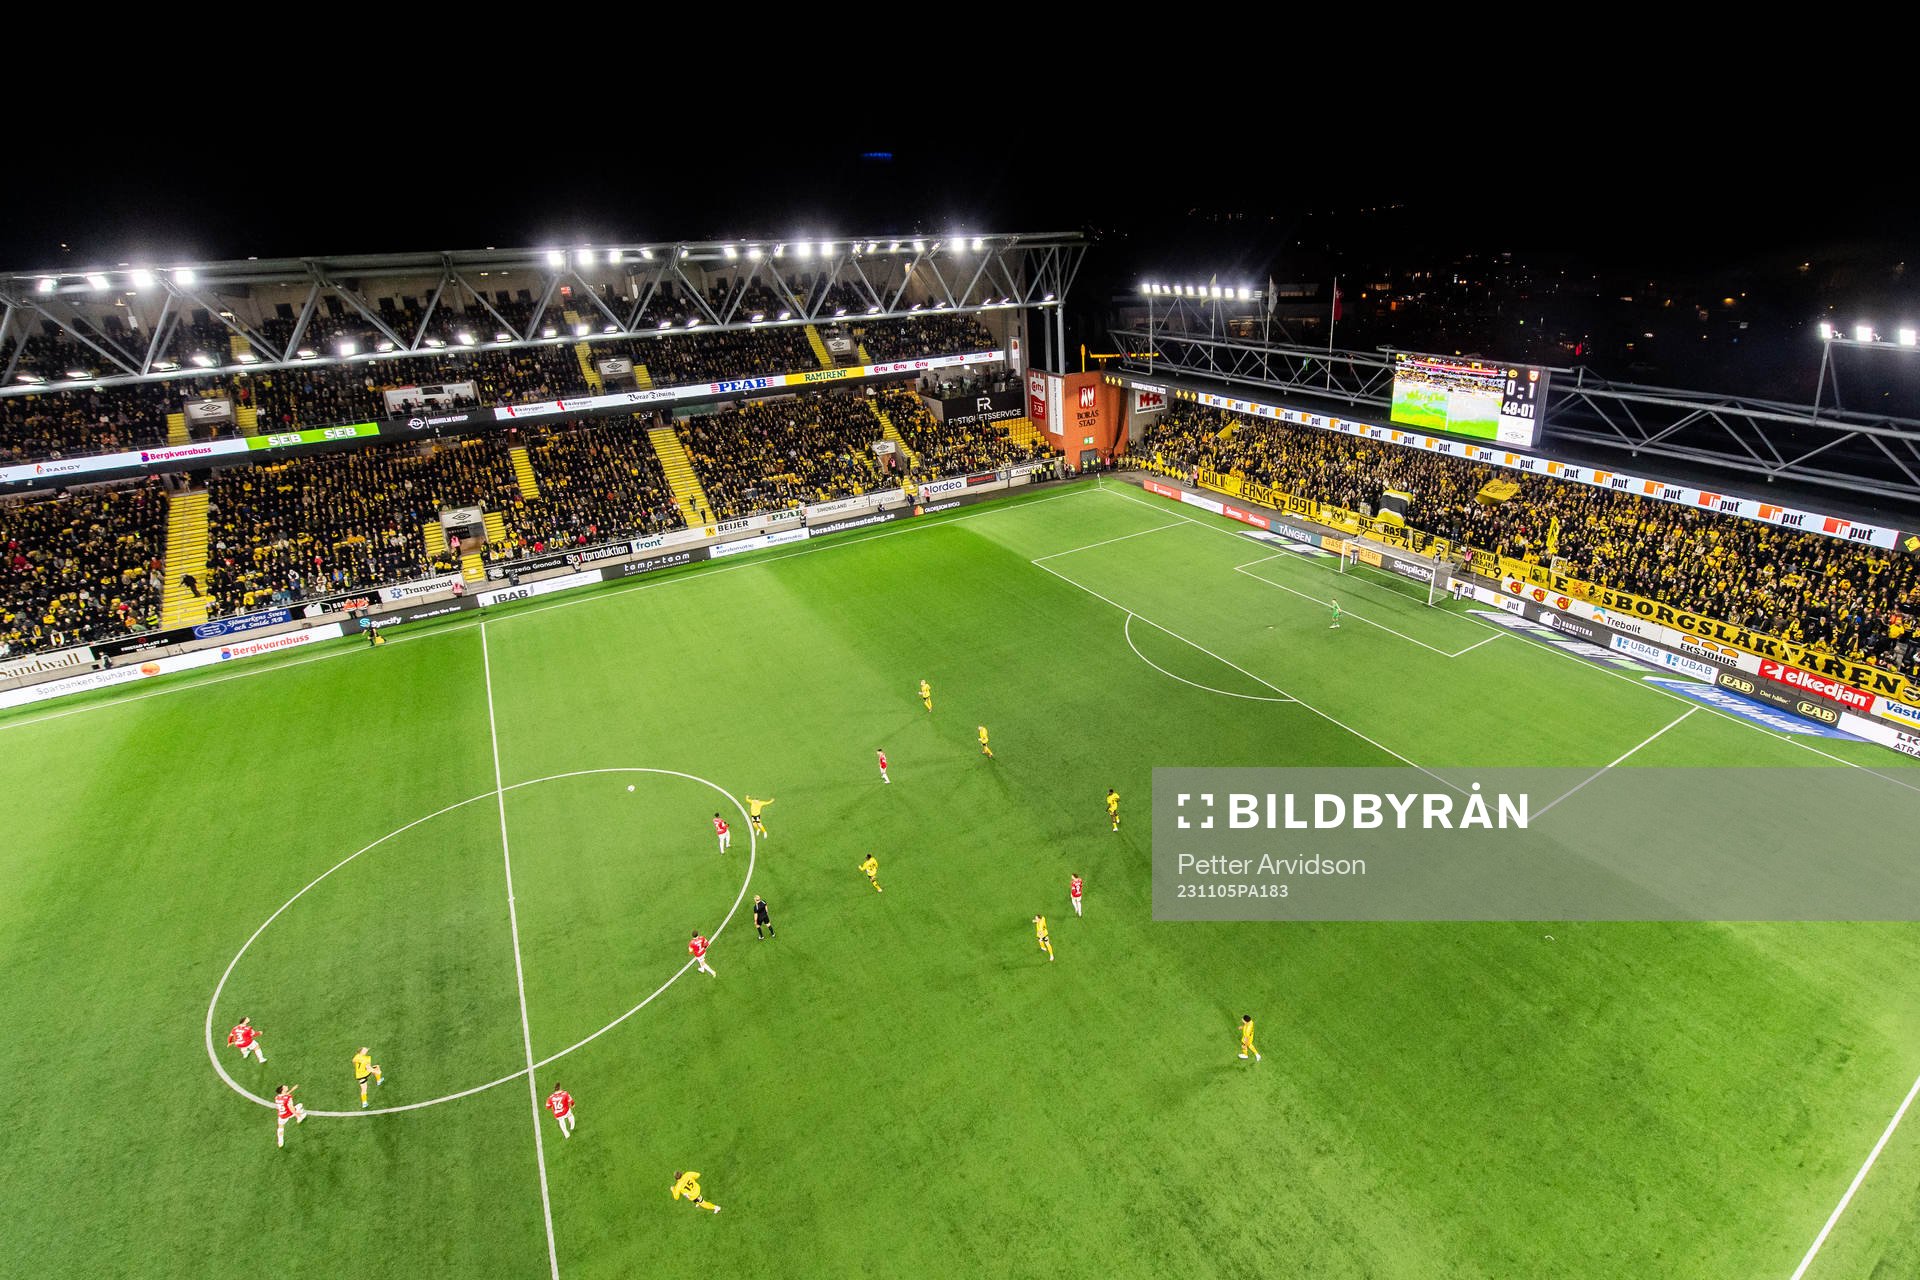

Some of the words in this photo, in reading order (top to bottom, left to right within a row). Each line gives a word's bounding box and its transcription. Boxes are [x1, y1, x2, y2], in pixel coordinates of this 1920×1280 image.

[805, 370, 847, 382] RAMIRENT
[718, 378, 767, 392] PEAB
[1506, 379, 1515, 396] 0
[1528, 382, 1536, 399] 1
[977, 398, 992, 412] FR
[1502, 401, 1534, 418] 48:01
[1079, 419, 1096, 428] STAD
[268, 433, 302, 448] SEB
[324, 427, 357, 440] SEB
[150, 445, 212, 461] Bergkvarabuss
[929, 480, 962, 494] ordea
[816, 503, 847, 513] SIMONSLAND
[1288, 495, 1312, 515] 1991
[717, 519, 749, 532] BEIJER
[1279, 525, 1312, 543] TÅNGEN
[636, 537, 661, 550] front
[533, 560, 561, 569] Granada
[403, 580, 453, 595] Tranpenad
[493, 589, 528, 604] IBAB
[227, 614, 267, 627] Sjömarkens
[248, 620, 270, 629] Smide
[271, 617, 284, 625] AB
[371, 616, 402, 628] Syncify
[1606, 616, 1641, 634] Trebolit
[232, 634, 310, 656] Bergkvarabuss
[1630, 641, 1659, 658] UBAB
[0, 652, 81, 679] Sandwall
[1681, 658, 1712, 675] UBAB
[36, 678, 94, 696] Sparbanken
[1722, 675, 1752, 692] EAB
[1785, 670, 1866, 707] elkedjan
[1801, 703, 1834, 722] EAB
[684, 1180, 695, 1192] 15
